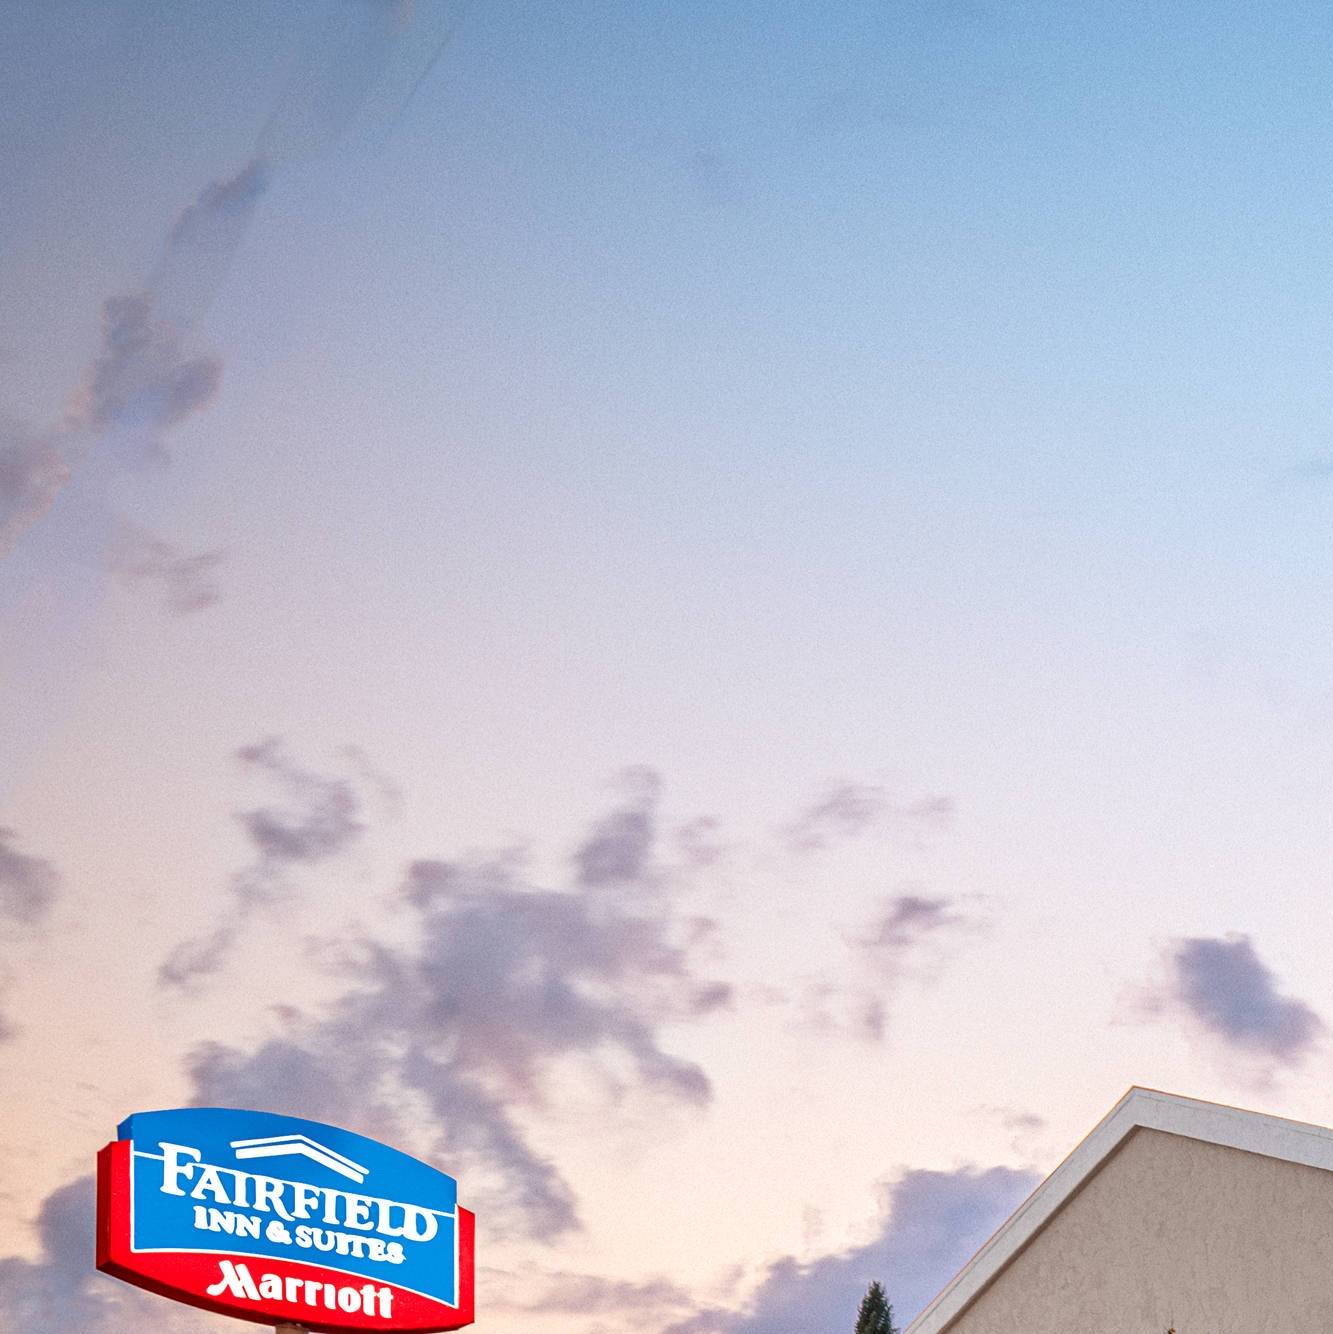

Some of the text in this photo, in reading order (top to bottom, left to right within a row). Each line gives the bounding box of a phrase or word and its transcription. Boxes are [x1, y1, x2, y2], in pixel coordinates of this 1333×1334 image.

[158, 1142, 439, 1242] FAIRFIELD
[193, 1205, 407, 1264] INN & SUITES
[206, 1260, 394, 1319] Marriott
